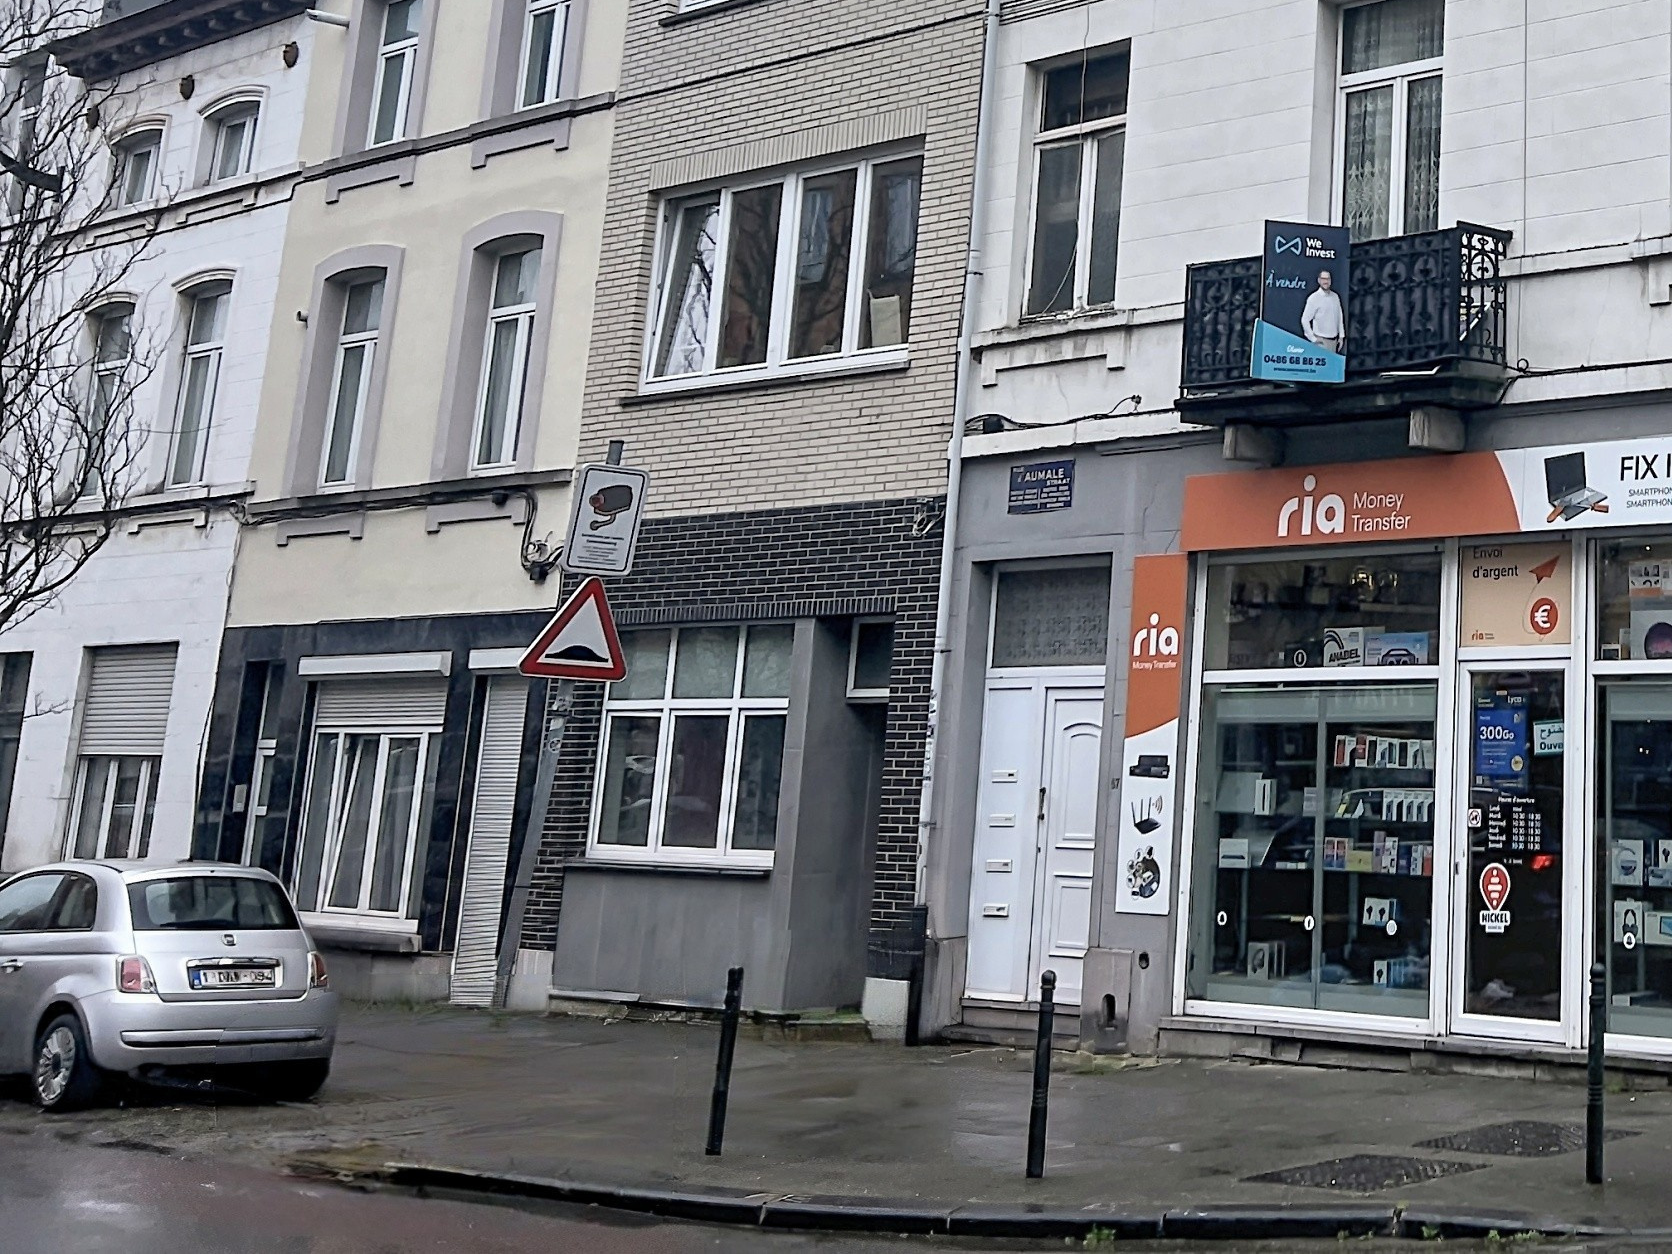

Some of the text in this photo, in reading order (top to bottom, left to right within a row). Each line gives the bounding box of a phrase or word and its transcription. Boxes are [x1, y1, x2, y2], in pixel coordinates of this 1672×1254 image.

[1306, 237, 1322, 248] We
[1306, 248, 1335, 259] Invest
[1276, 276, 1306, 290] vendre
[1264, 355, 1287, 365] 0486
[1315, 358, 1326, 366] 25
[1620, 454, 1659, 481] FIX
[1046, 478, 1071, 486] STRAAT
[1277, 474, 1346, 537] ria
[1353, 492, 1404, 511] Money
[1352, 511, 1411, 532] Transfer
[1473, 546, 1503, 559] Envoi
[1473, 565, 1518, 580] d'argent
[1133, 613, 1179, 656] ria
[1471, 630, 1484, 640] ria
[1481, 912, 1508, 923] NICKEL
